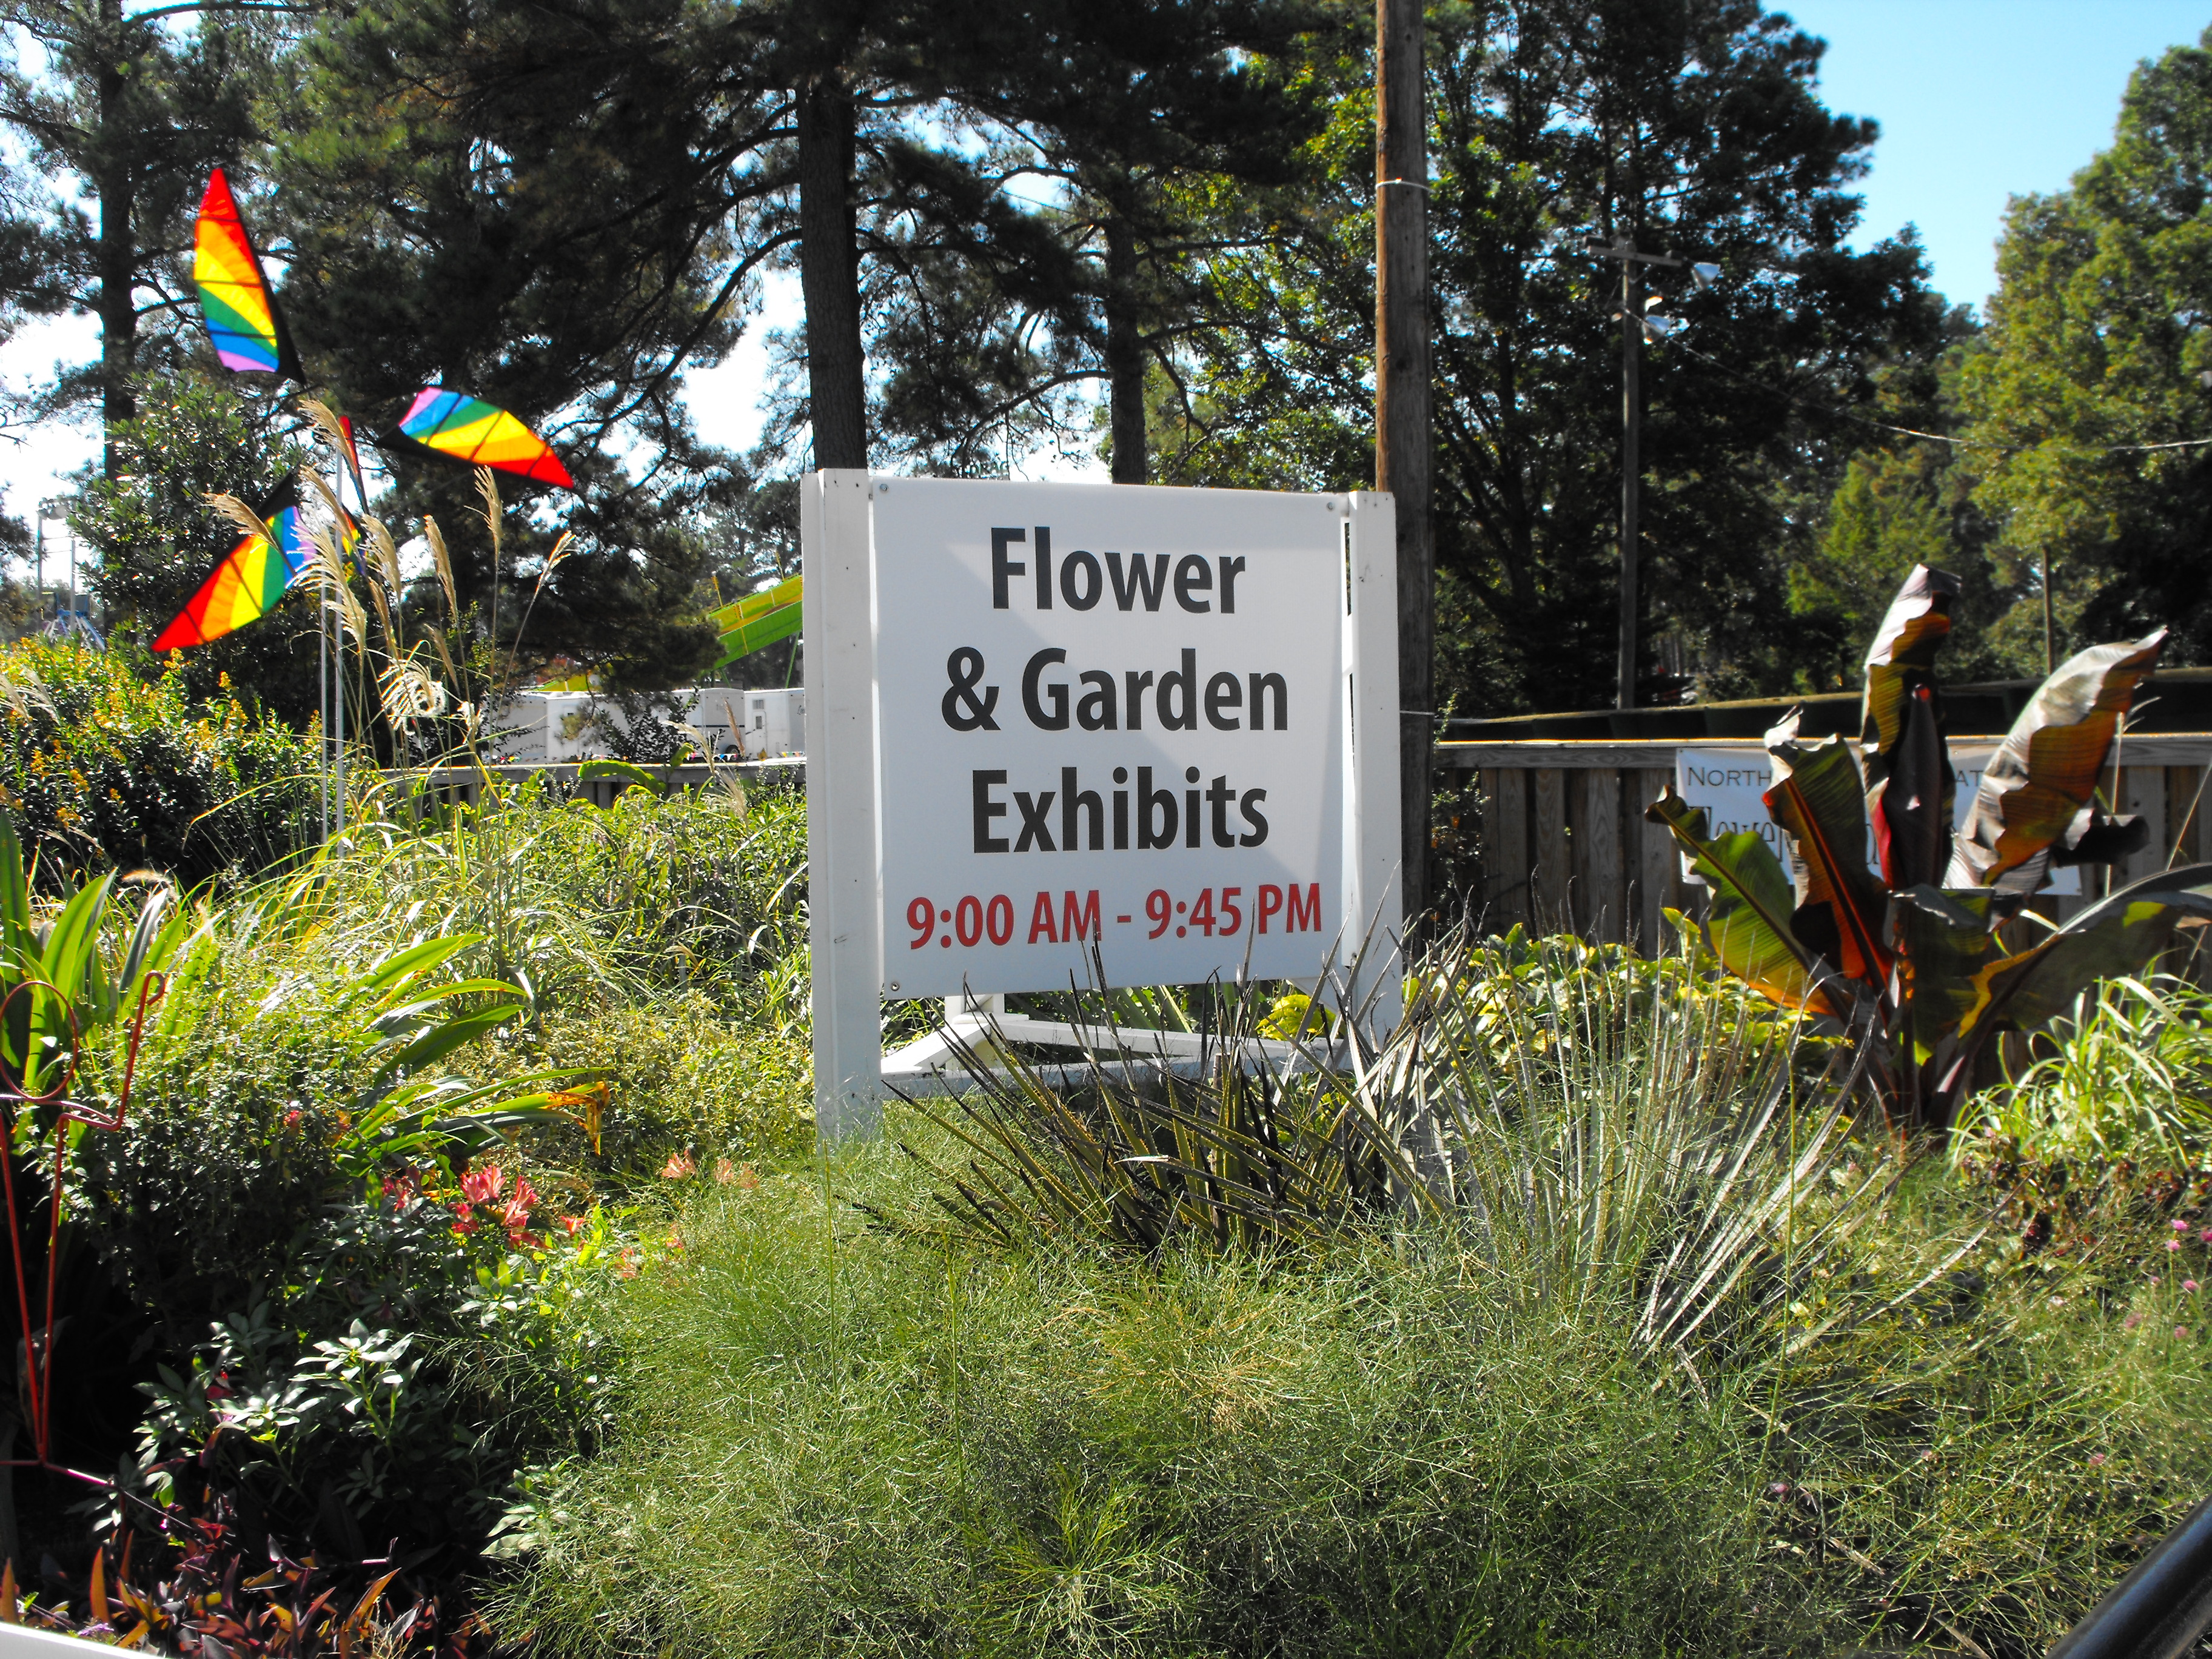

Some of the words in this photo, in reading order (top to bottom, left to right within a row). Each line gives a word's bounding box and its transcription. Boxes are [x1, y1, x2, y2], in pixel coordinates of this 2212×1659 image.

[991, 526, 1246, 614] Flower
[941, 646, 1001, 732] &
[1021, 647, 1289, 731] Garden
[972, 765, 1269, 854] Exhibits
[1688, 767, 1771, 786] NORTH
[907, 894, 1014, 950] 9:00
[1028, 890, 1102, 944] AM
[1145, 886, 1242, 939] 9:45
[1258, 882, 1322, 934] PM
